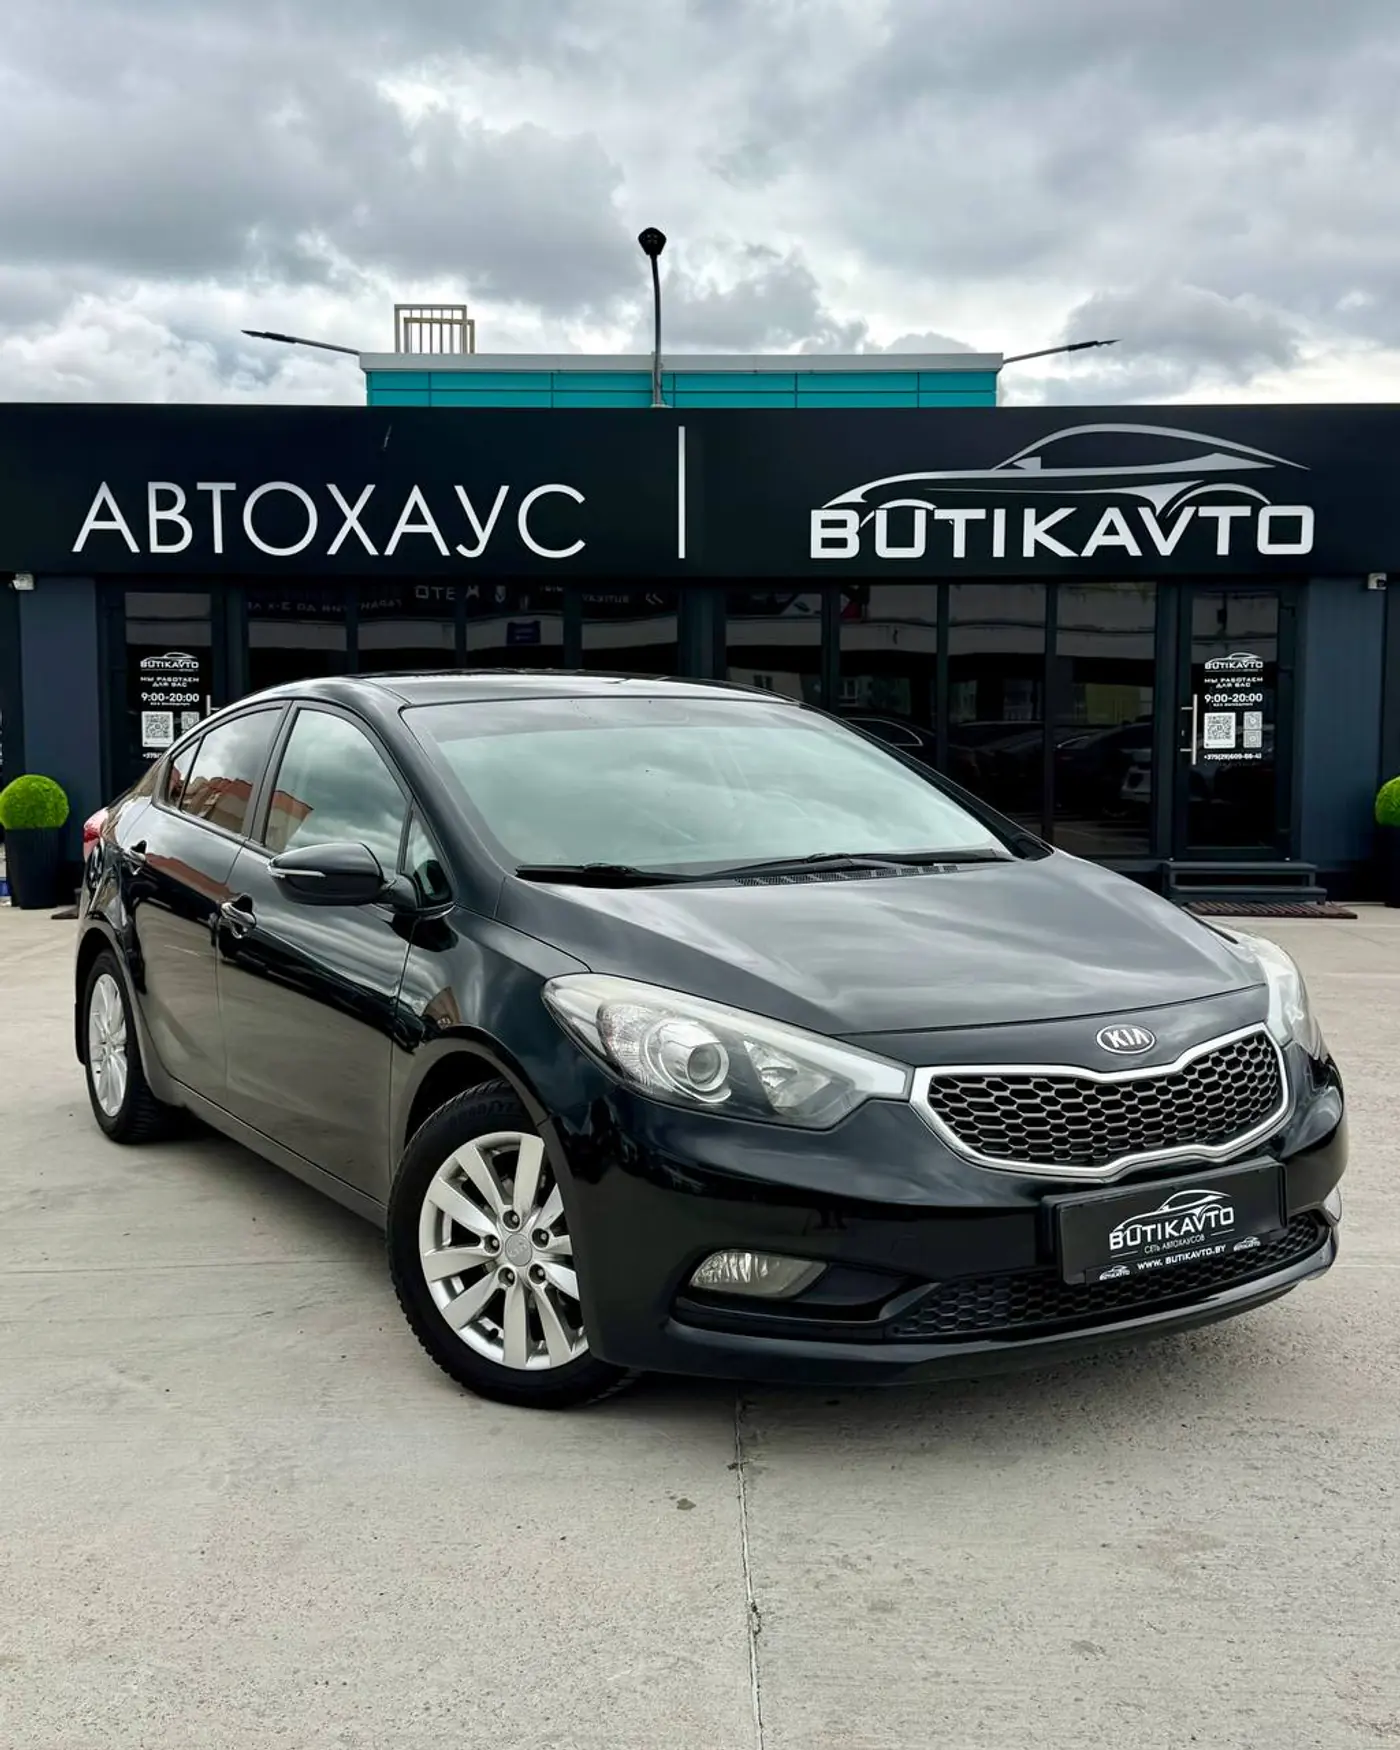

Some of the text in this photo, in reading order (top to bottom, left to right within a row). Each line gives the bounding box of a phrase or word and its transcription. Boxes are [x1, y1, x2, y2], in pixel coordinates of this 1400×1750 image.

[71, 480, 586, 559] АВТОХАУС
[810, 504, 1315, 559] BUTIKAVTO
[140, 660, 199, 669] BUTIKAVTO
[1204, 661, 1263, 670] BUTIKAVTO
[141, 692, 200, 703] 9:00-20:00
[1204, 693, 1263, 704] 9:00-20:00
[1104, 1027, 1150, 1048] KIA
[1109, 1206, 1235, 1250] BUTIKAVTO
